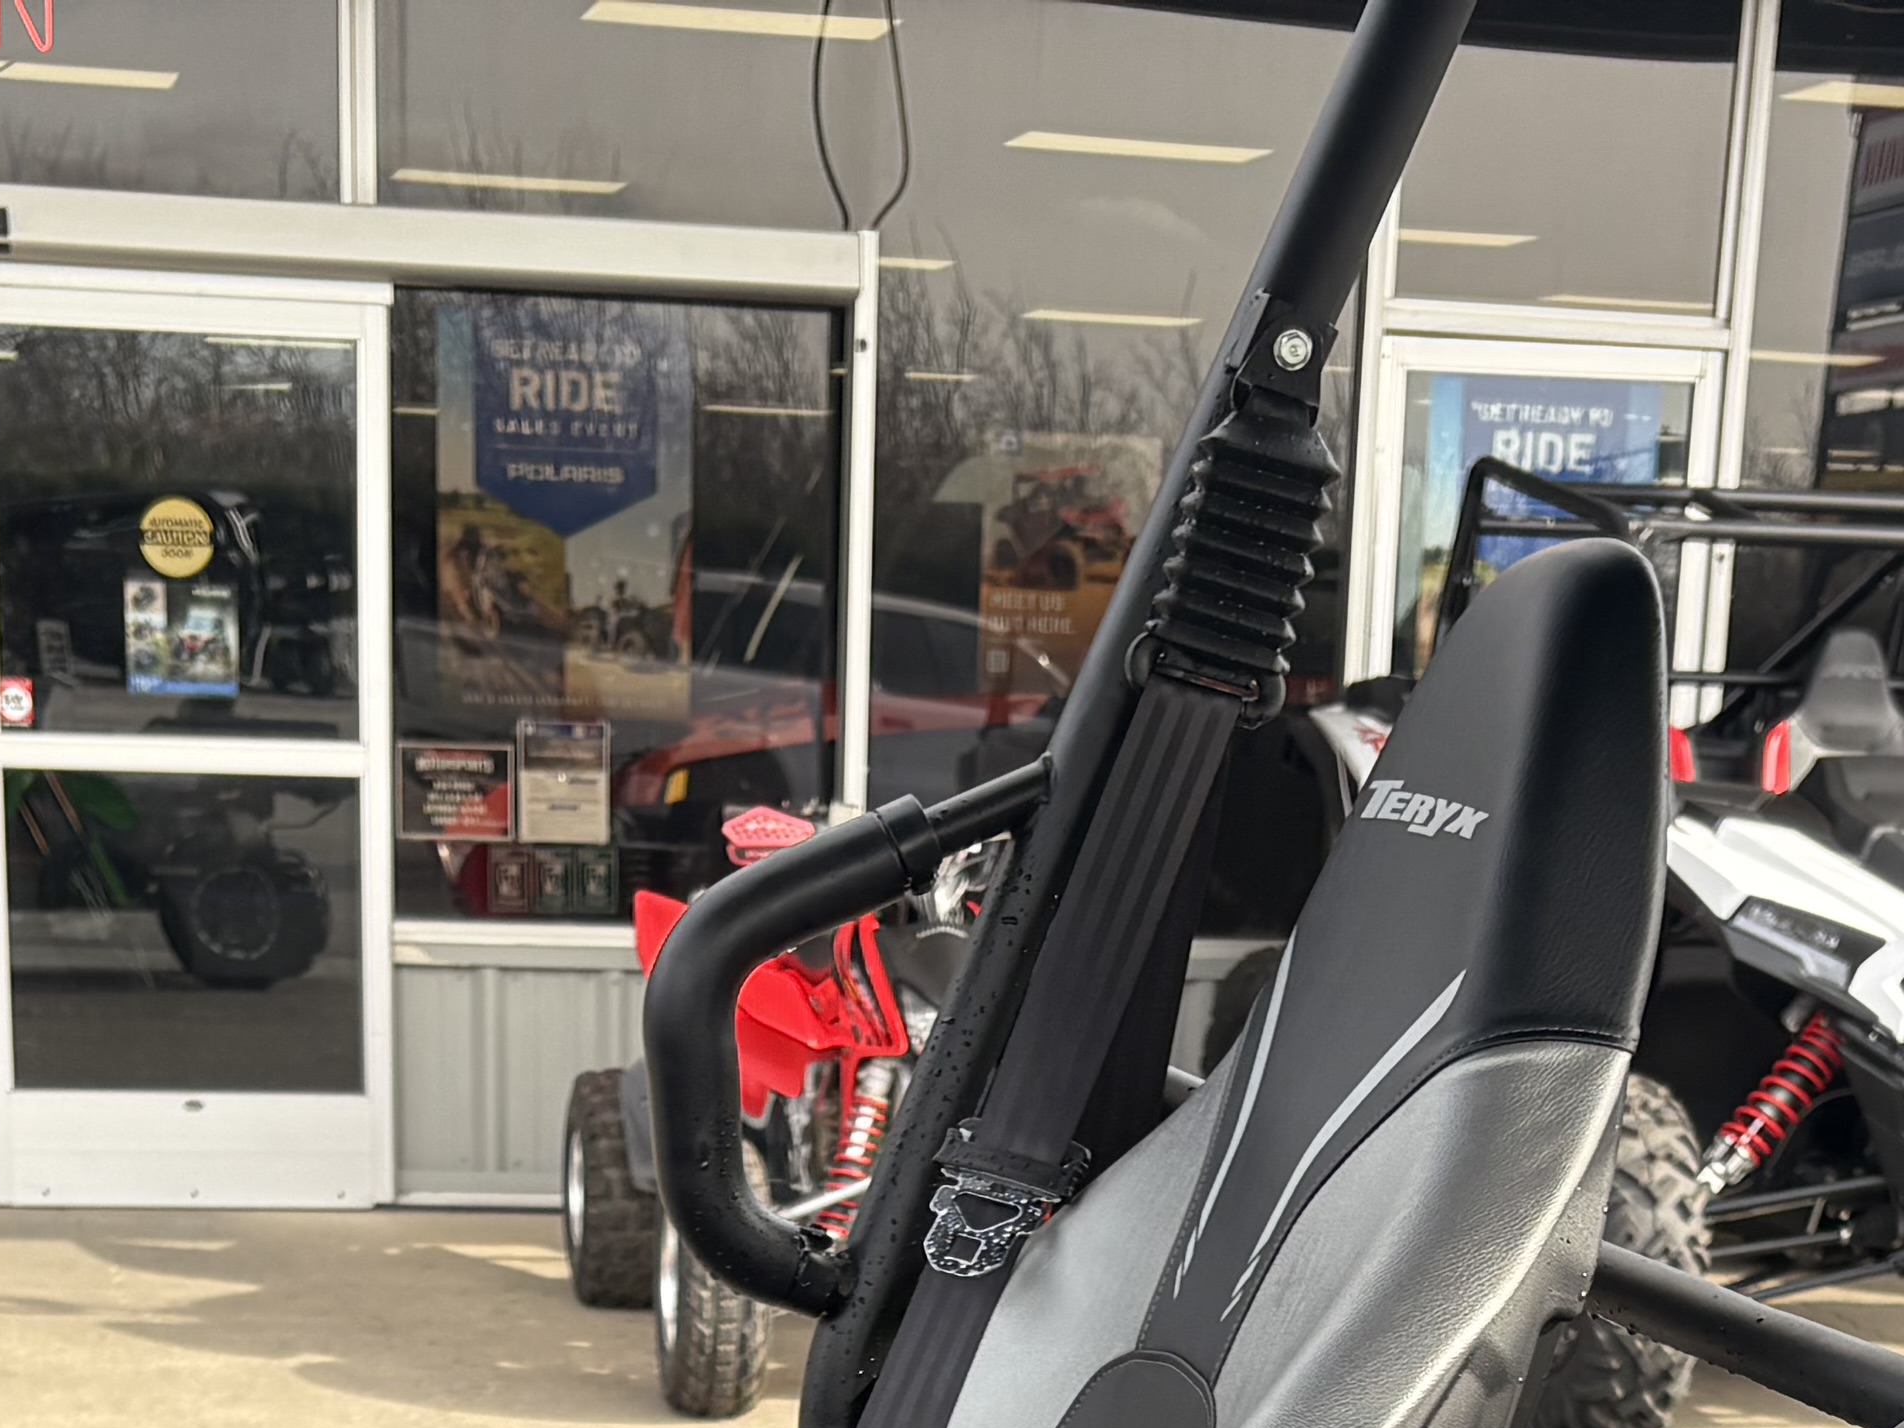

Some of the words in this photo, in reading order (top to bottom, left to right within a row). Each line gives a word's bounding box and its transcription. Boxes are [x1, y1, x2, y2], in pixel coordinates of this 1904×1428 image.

[508, 367, 625, 416] RIDE
[1492, 428, 1598, 476] RIDE
[506, 462, 626, 484] POLARIS
[144, 530, 211, 546] CAUTION
